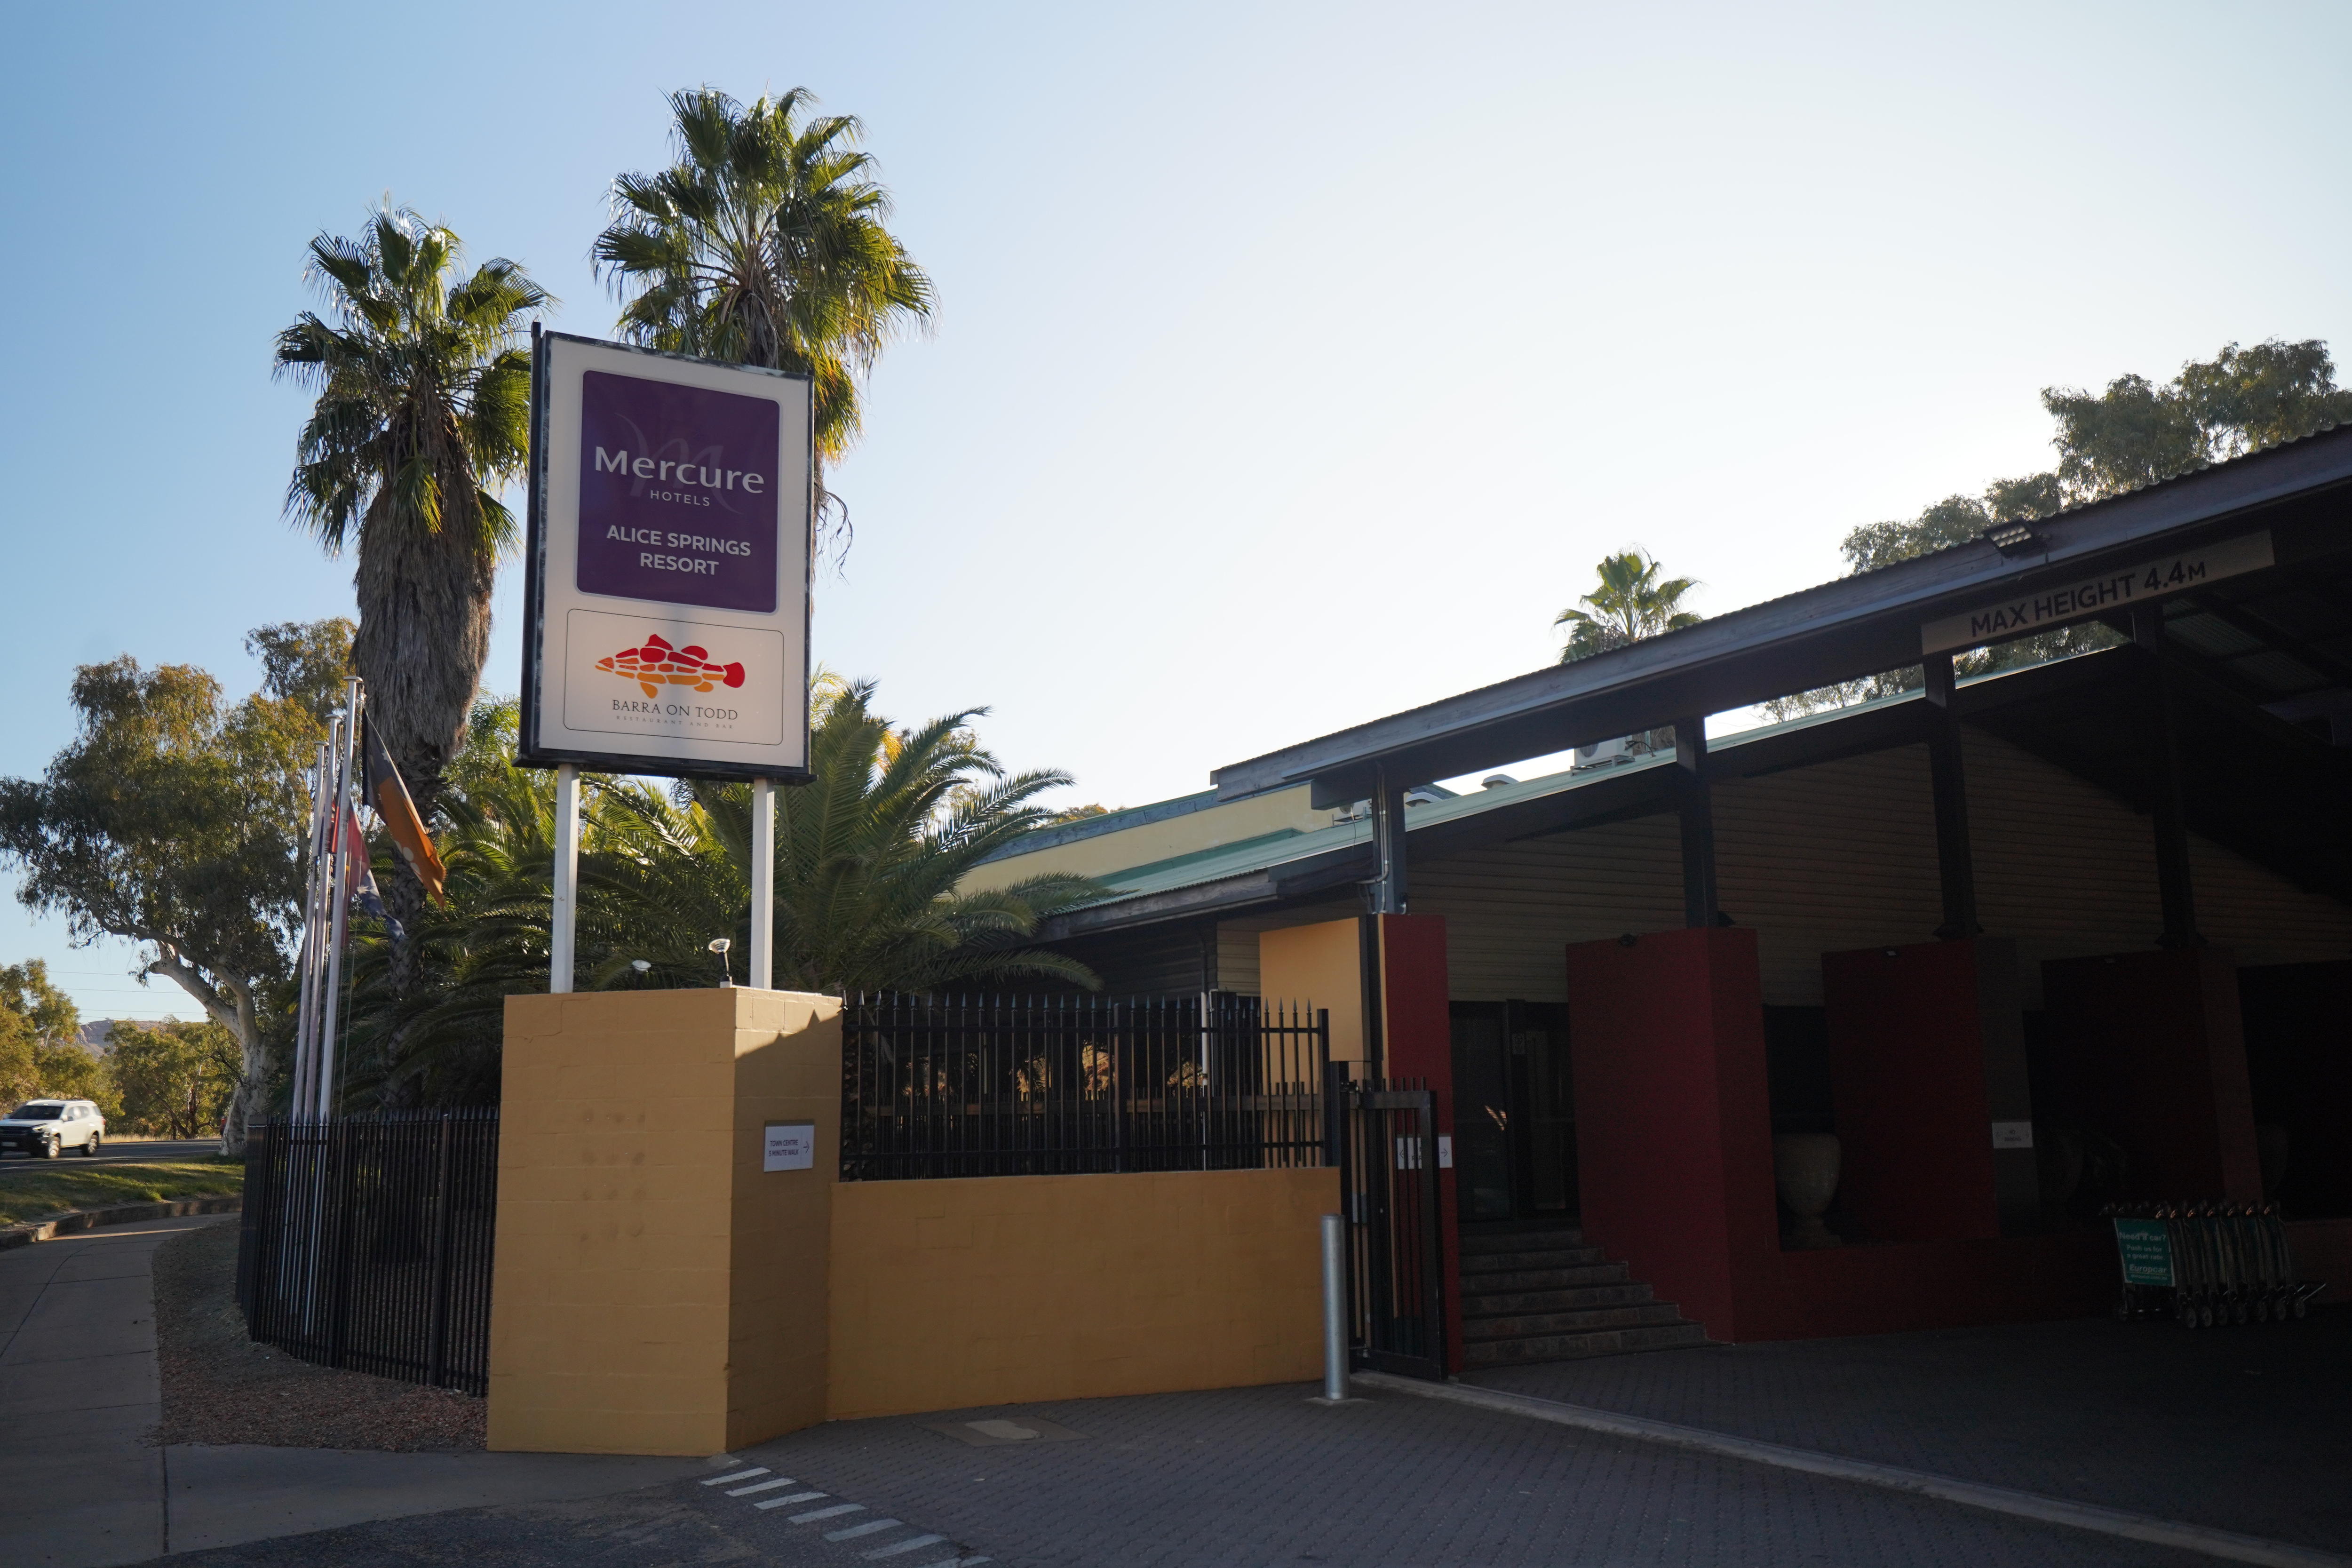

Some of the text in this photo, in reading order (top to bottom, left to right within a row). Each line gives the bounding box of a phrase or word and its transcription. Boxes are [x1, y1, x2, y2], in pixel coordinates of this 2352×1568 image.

[595, 446, 764, 494] Mercure
[650, 489, 710, 507] HOTELS
[607, 525, 751, 557] ALICE SPRINGS
[640, 553, 719, 575] RESORT
[1971, 561, 2206, 638] MAX HEIGHT 4.4M
[612, 700, 738, 720] BARRA ON TODD
[616, 716, 683, 724] RESTAURANT
[2119, 1232, 2139, 1240] Need
[2130, 1264, 2167, 1273] Europcar
